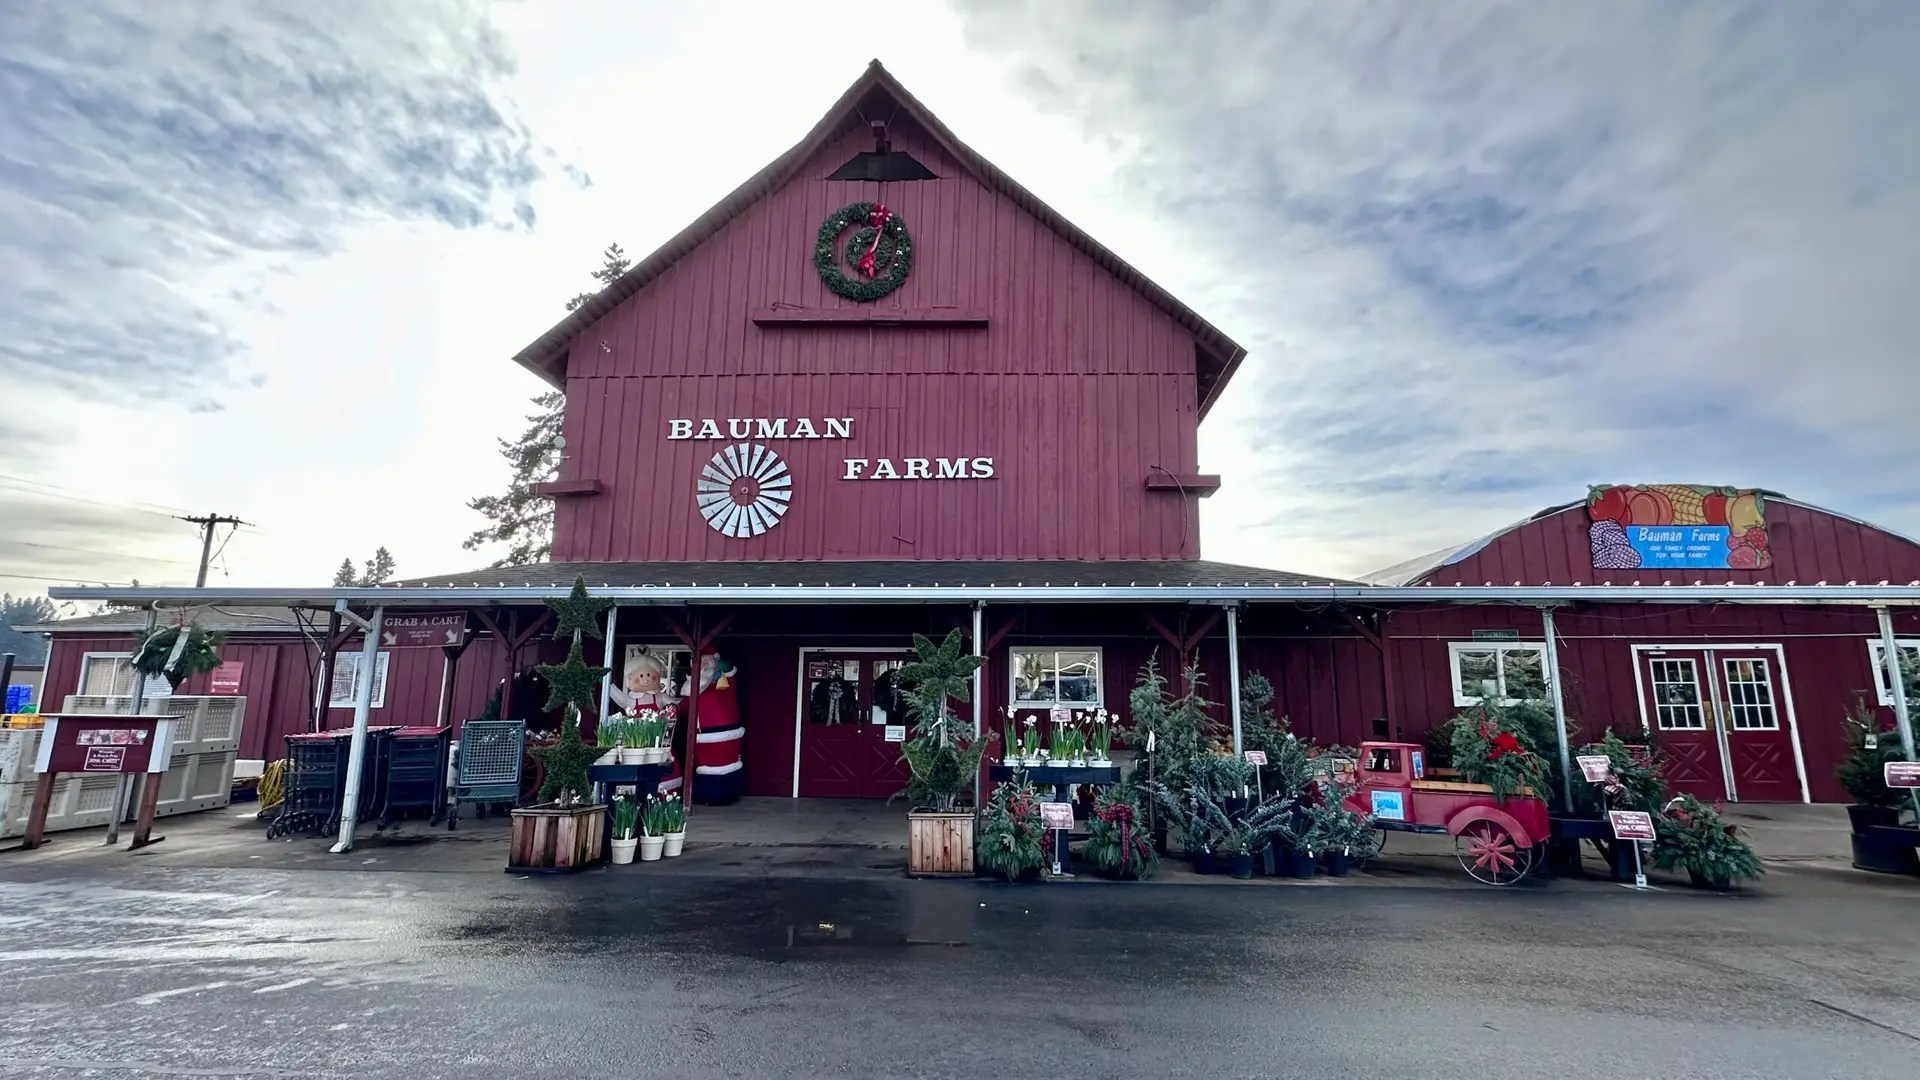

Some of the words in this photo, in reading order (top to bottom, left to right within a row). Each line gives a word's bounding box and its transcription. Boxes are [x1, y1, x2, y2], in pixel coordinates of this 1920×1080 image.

[667, 417, 854, 440] BAUMAN
[843, 457, 995, 480] FARMS
[1638, 527, 1683, 542] Bauman
[1691, 529, 1720, 542] Farms
[384, 617, 418, 627] GRAB
[420, 617, 428, 626] A
[431, 615, 461, 626] CART
